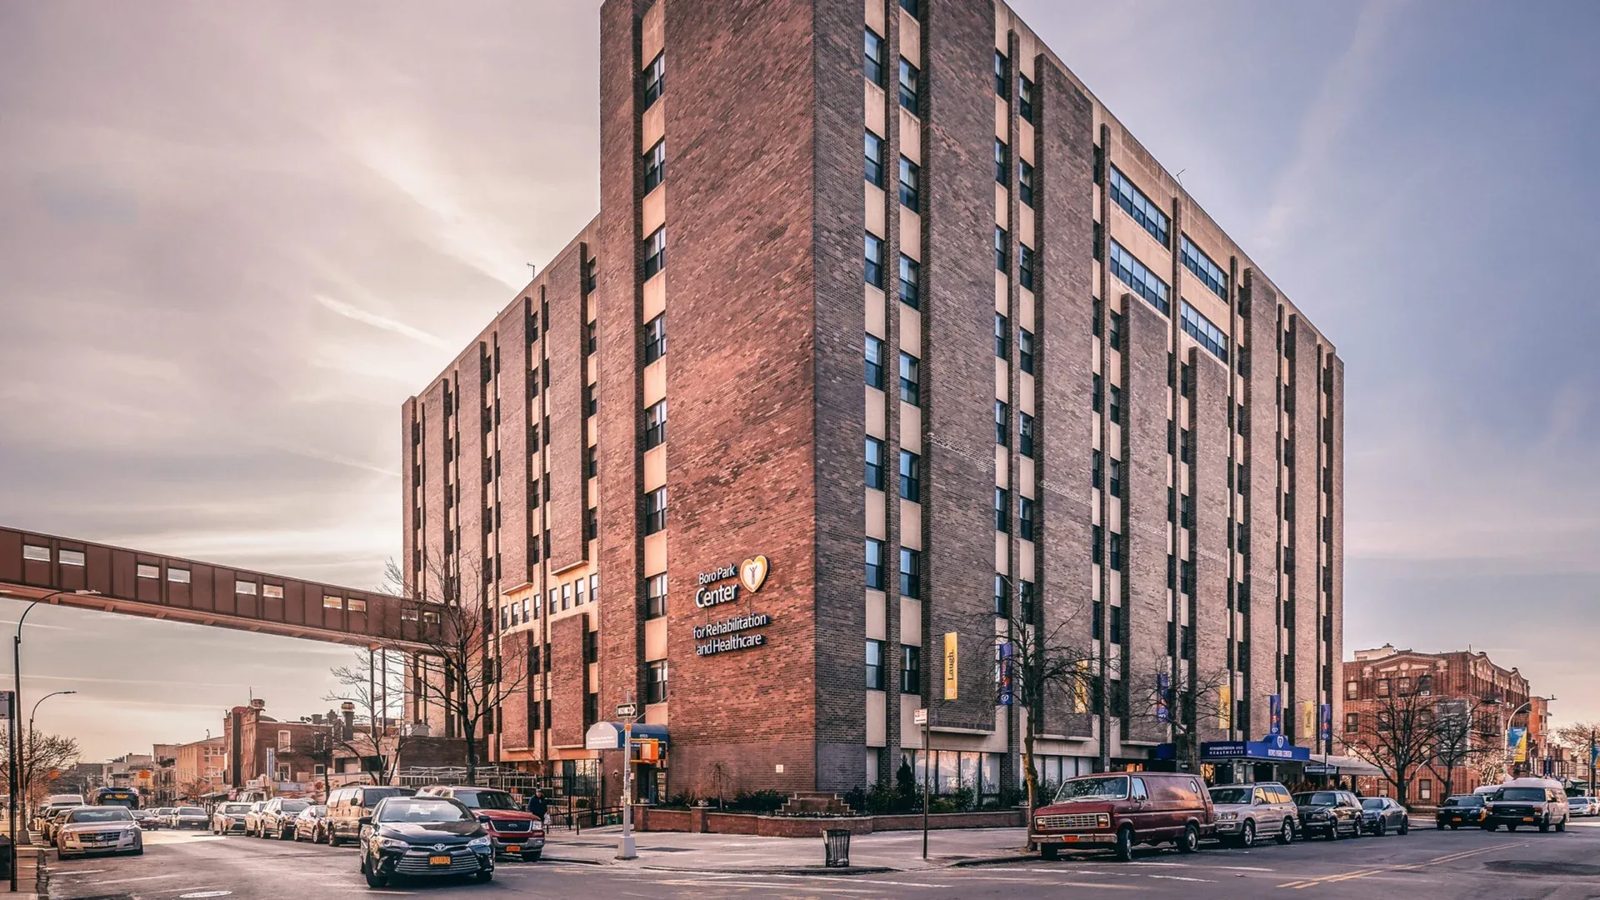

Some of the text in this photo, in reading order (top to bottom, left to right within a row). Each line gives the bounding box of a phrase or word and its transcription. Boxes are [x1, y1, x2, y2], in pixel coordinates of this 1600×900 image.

[698, 564, 735, 585] Boro Park
[695, 584, 737, 608] Center
[693, 614, 767, 639] for Rehabilitation
[697, 634, 762, 655] and Healthcare
